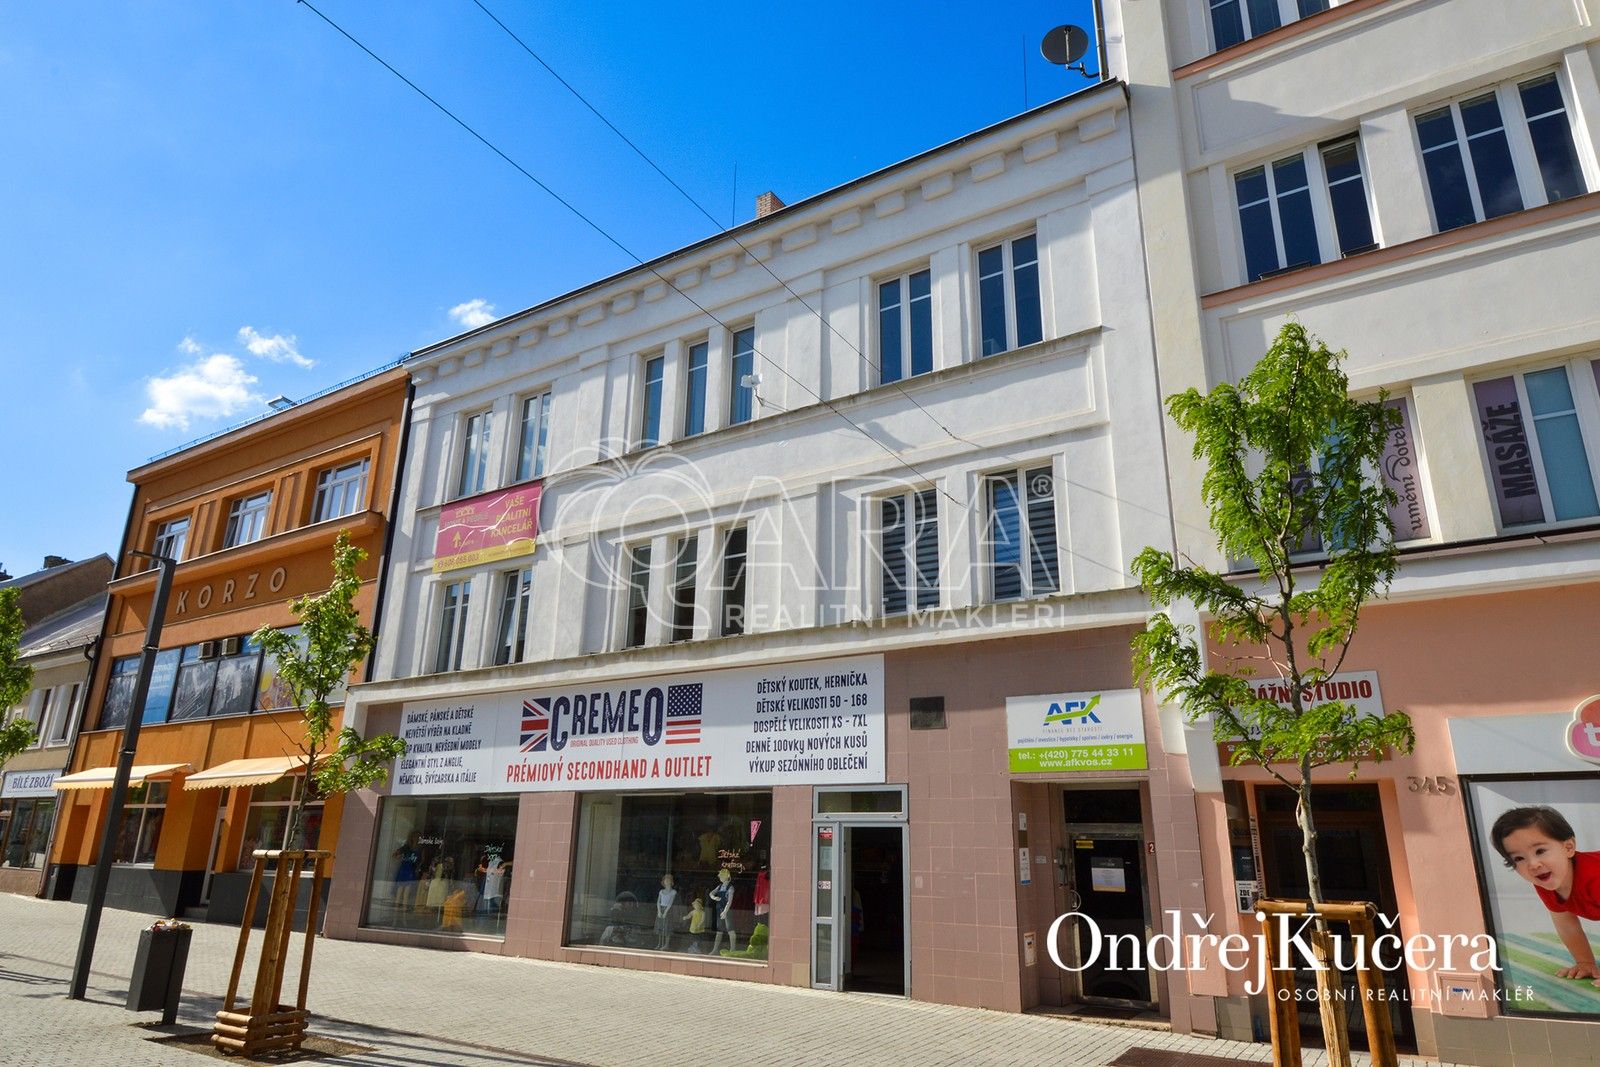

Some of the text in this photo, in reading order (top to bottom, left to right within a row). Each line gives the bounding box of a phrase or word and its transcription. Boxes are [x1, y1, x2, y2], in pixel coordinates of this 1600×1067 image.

[1481, 401, 1537, 499] MASÁŽE
[491, 520, 533, 538] KANCELÁŘ
[176, 567, 286, 614] KORZO
[758, 670, 867, 694] DĚTSKÝ KOUTEK, HERNIČKA
[1302, 680, 1373, 702] STUDIO
[430, 706, 450, 721] PÁNSKÉ
[455, 704, 474, 720] DĚTSKÉ
[757, 696, 785, 713] DĚTSKÉ
[787, 696, 827, 712] VELIKOSTI
[830, 696, 841, 709] 50
[851, 694, 867, 707] 168
[1043, 697, 1101, 726] AFK
[551, 687, 664, 751] CREMEO
[754, 715, 787, 733] DOSPĚLÉ
[789, 715, 829, 731] VELIKOSTI
[831, 716, 843, 729] XS
[852, 714, 867, 727] 7XL
[427, 723, 443, 737] VÝBĚR
[444, 726, 451, 736] NA
[460, 739, 482, 750] MODELY
[746, 730, 867, 754] DENNĚ 100vky NOVÝCH KUSŮ
[427, 757, 439, 768] STYL
[749, 751, 868, 773] VÝKUP SEZÓNNÍHO OBLEČENÍ
[1018, 747, 1134, 760] tel.: +(420) 775 44 33 11
[1039, 758, 1113, 768] www.afkvos.cz
[460, 769, 477, 782] ITÁLIE
[506, 755, 712, 783] PRÉMIOVÝ SECONDHAND A OUTLET
[12, 773, 54, 789] BÍLÉ ZBOŽÍ
[1407, 776, 1448, 793] 345
